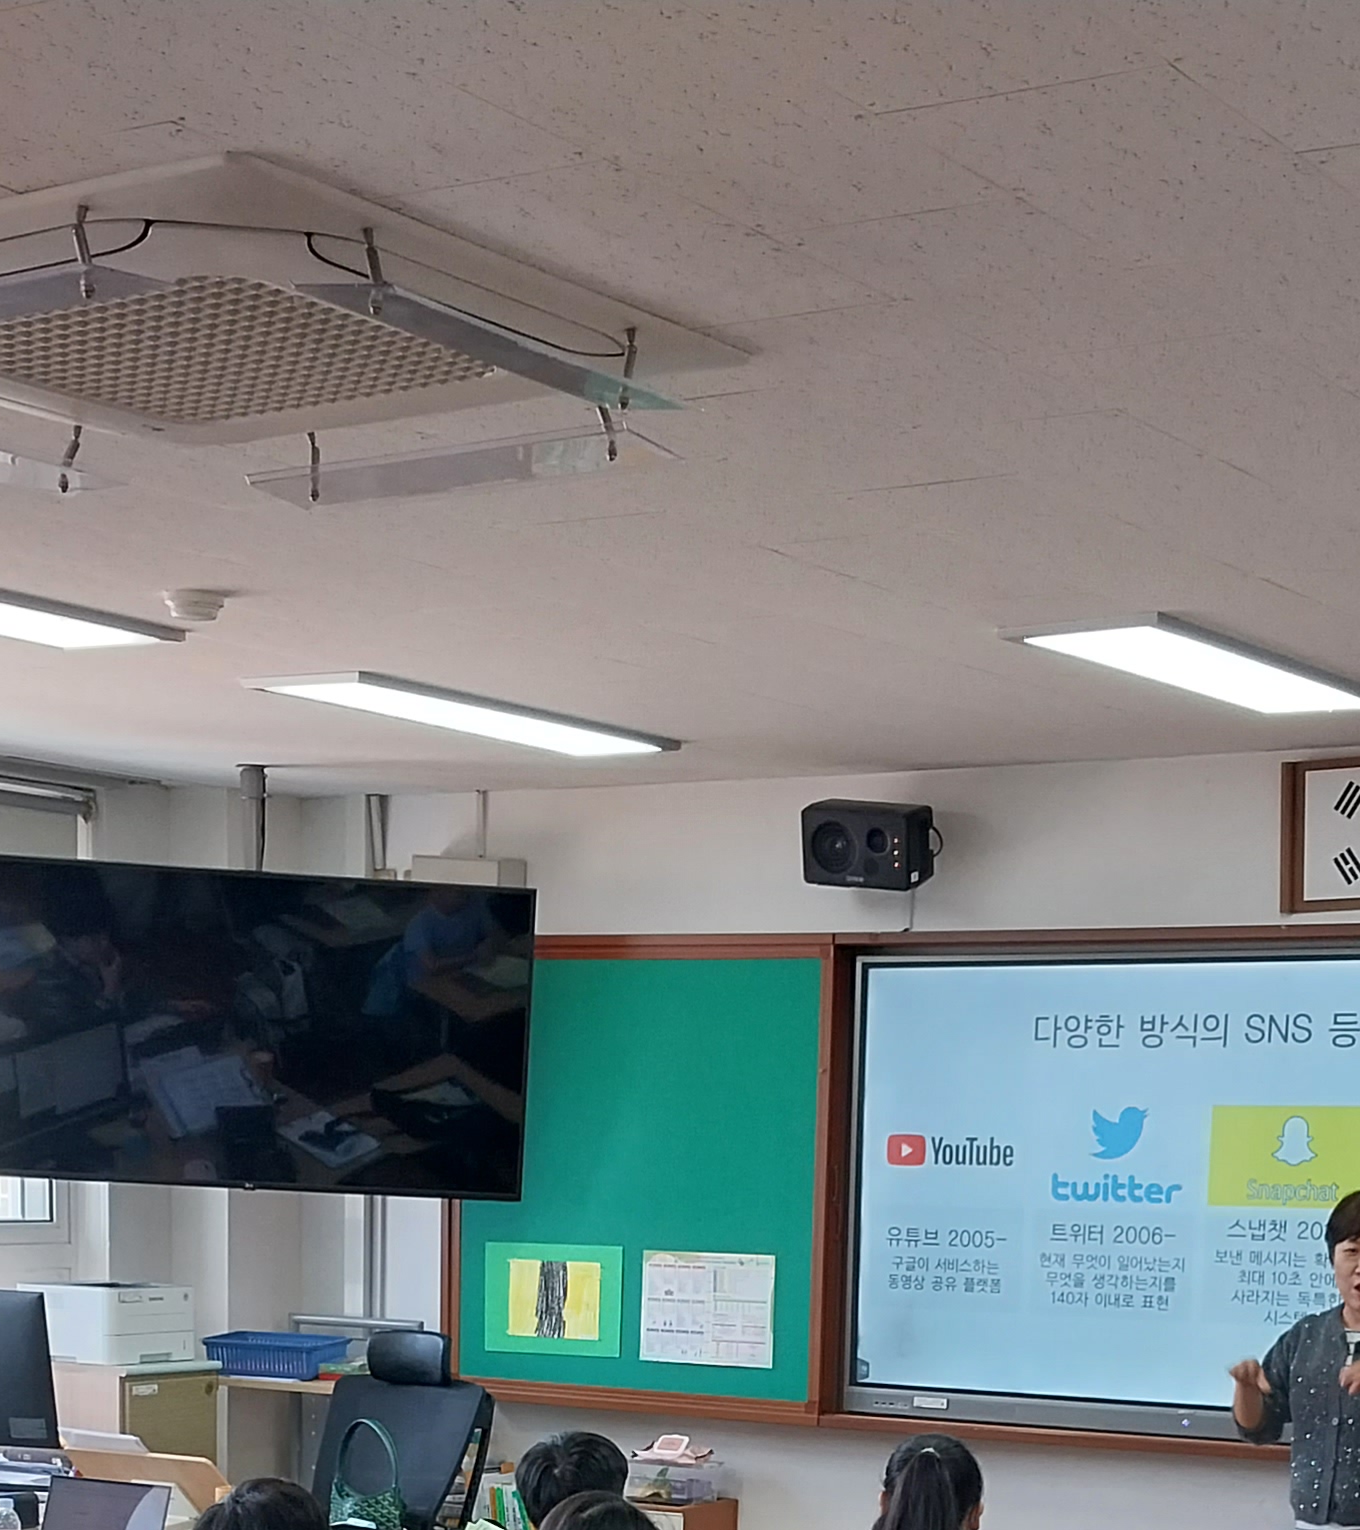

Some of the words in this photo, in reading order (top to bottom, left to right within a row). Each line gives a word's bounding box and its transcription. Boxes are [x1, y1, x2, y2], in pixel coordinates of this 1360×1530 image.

[1034, 1013, 1125, 1049] 다양한
[1139, 1013, 1230, 1049] 방식의
[1244, 1013, 1313, 1044] SNS
[931, 1136, 1014, 1167] YouTube
[1051, 1173, 1183, 1204] twitter
[1246, 1178, 1339, 1206] Snapchat
[886, 1226, 940, 1248] 유튜브
[947, 1229, 1007, 1249] 2005-
[1049, 1223, 1104, 1246] 트위터
[1112, 1225, 1177, 1246] 2006-
[1226, 1219, 1288, 1242] 스냅챗
[1297, 1220, 1327, 1241] 20
[891, 1256, 930, 1272] 구글이
[934, 1257, 1000, 1275] 서비스하는
[1039, 1252, 1066, 1269] 현재
[1072, 1253, 1111, 1271] 무엇이
[1116, 1254, 1186, 1273] 일어났는지
[1213, 1250, 1244, 1265] 보낸
[1249, 1251, 1307, 1268] 메시지는
[1313, 1253, 1330, 1268] 확
[887, 1275, 925, 1291] 동영상
[931, 1276, 957, 1292] 공유
[962, 1277, 1002, 1294] 플랫폼
[1045, 1272, 1085, 1289] 무엇을
[1090, 1273, 1177, 1293] 생각하는지를
[1237, 1270, 1265, 1286] 최대
[1271, 1271, 1303, 1287] 10초
[1050, 1290, 1089, 1307] 140자
[1094, 1292, 1135, 1309] 이내로
[1141, 1294, 1170, 1312] 표현
[1231, 1290, 1290, 1308] 사라지는
